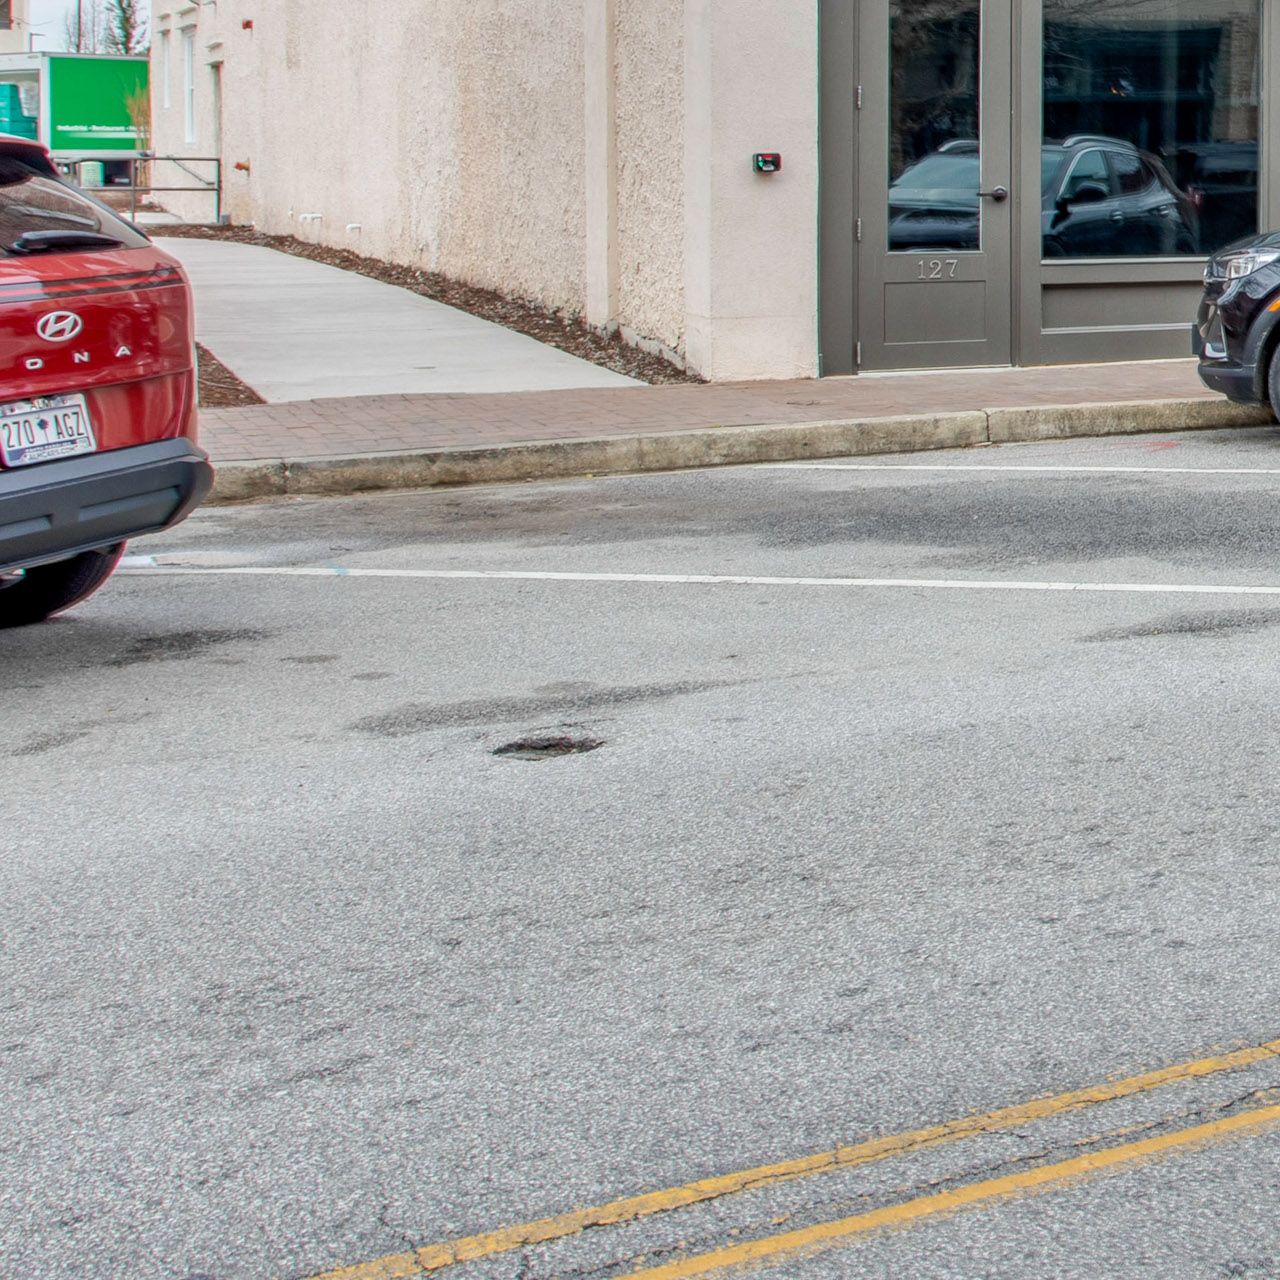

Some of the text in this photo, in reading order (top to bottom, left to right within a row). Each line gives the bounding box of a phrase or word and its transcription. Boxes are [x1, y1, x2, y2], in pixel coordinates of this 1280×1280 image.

[918, 259, 958, 279] 127
[2, 411, 84, 449] 270 AGZ
